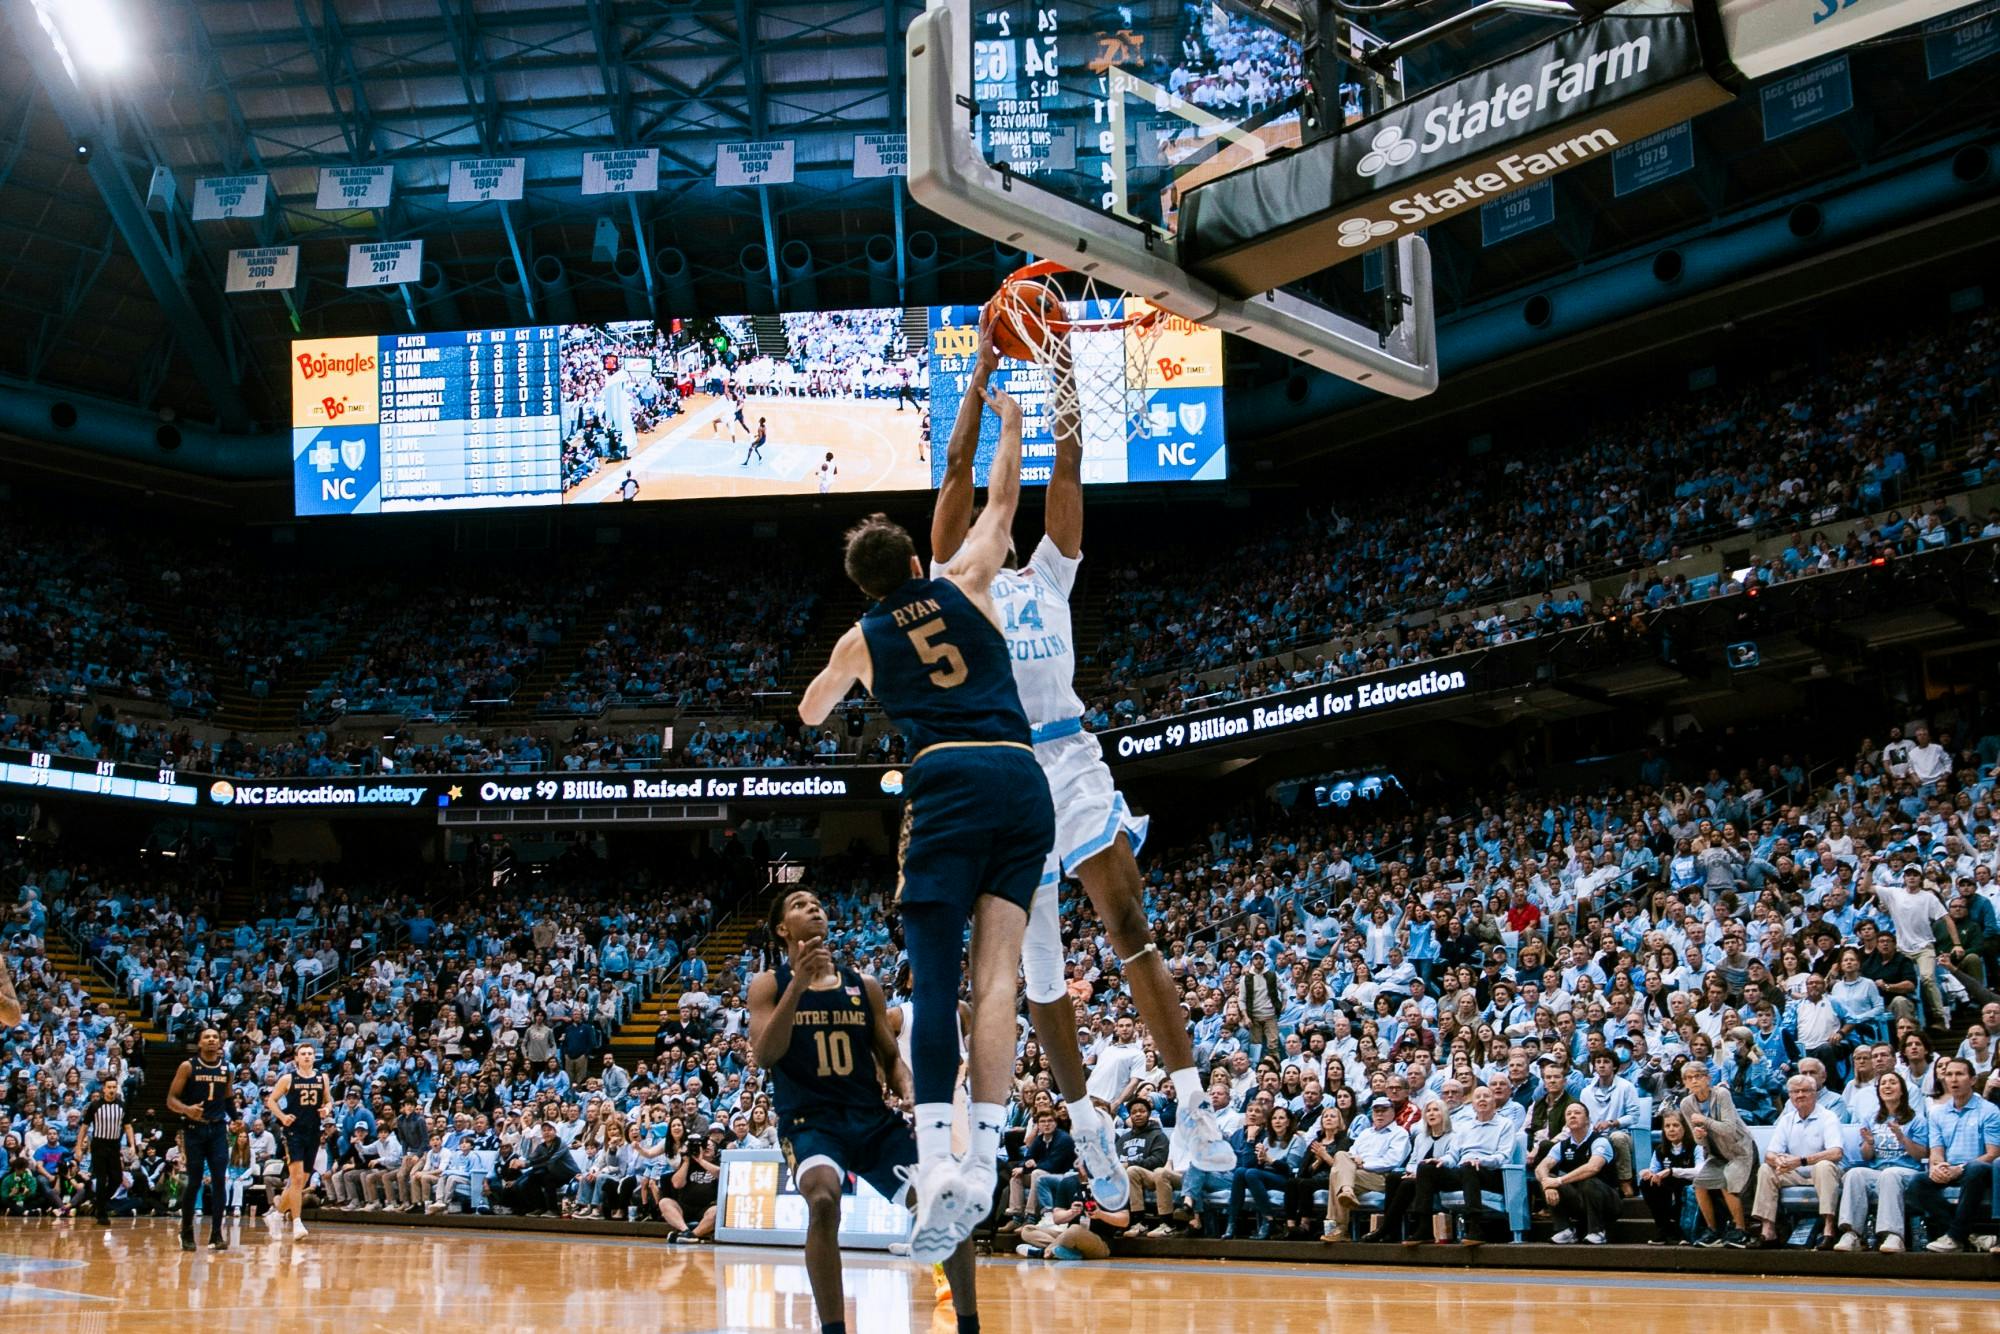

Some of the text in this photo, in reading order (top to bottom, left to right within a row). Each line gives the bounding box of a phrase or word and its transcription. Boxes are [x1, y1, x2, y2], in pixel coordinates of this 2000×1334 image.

[1790, 85, 1824, 109] 1981
[727, 142, 785, 154] FINAL NATIONAL
[738, 152, 773, 161] RANKING
[876, 144, 907, 153] RANKIN
[1637, 145, 1668, 168] 1979
[741, 161, 769, 173] 1994
[879, 153, 907, 166] 1998
[473, 177, 499, 190] 1984
[607, 169, 634, 181] 1993
[749, 175, 761, 184] #1
[342, 185, 369, 197] 1982
[1503, 197, 1531, 220] 1978
[248, 266, 275, 278] 2009
[372, 260, 398, 273] 2017
[397, 335, 426, 348] PLAYER
[466, 333, 482, 344] PTS
[514, 330, 531, 341] AST
[539, 328, 554, 340] FLS
[384, 341, 550, 364] 1 STARLING 7 3 3 1
[296, 352, 375, 380] Bojangles
[383, 365, 392, 379] 5
[470, 360, 479, 375] 8
[518, 358, 527, 372] 2
[543, 356, 550, 371] 1
[1011, 370, 1028, 382] PTS
[1157, 357, 1182, 382] Bo
[381, 379, 394, 393] 10
[470, 375, 479, 389] 7
[495, 373, 504, 388] 0
[518, 372, 528, 386] 3
[543, 371, 550, 385] 1
[322, 396, 345, 420] Bo
[381, 394, 394, 408] 13
[470, 389, 479, 404] 2
[495, 388, 504, 403] 2
[519, 387, 528, 401] 0
[543, 386, 552, 401] 3
[380, 409, 395, 424] 23
[471, 404, 480, 419] 8
[495, 403, 504, 418] 7
[520, 402, 526, 416] 1
[543, 401, 552, 416] 3
[1158, 443, 1196, 466] NC
[1020, 469, 1051, 481] SSISTS
[322, 478, 356, 500] NC
[891, 598, 942, 627] RYAN
[1003, 599, 1043, 633] 14
[907, 618, 969, 689] 5
[1117, 670, 1465, 757] Over $9 Billion Raised for Education
[96, 761, 116, 776] AST
[158, 770, 177, 785] STL
[235, 785, 428, 806] NC Education Lottery
[479, 776, 847, 801] Over $9 Billion Raised for Education
[832, 1011, 866, 1026] DAME
[813, 1030, 854, 1077] 10
[208, 1082, 215, 1100] 1
[300, 1089, 318, 1106] 23
